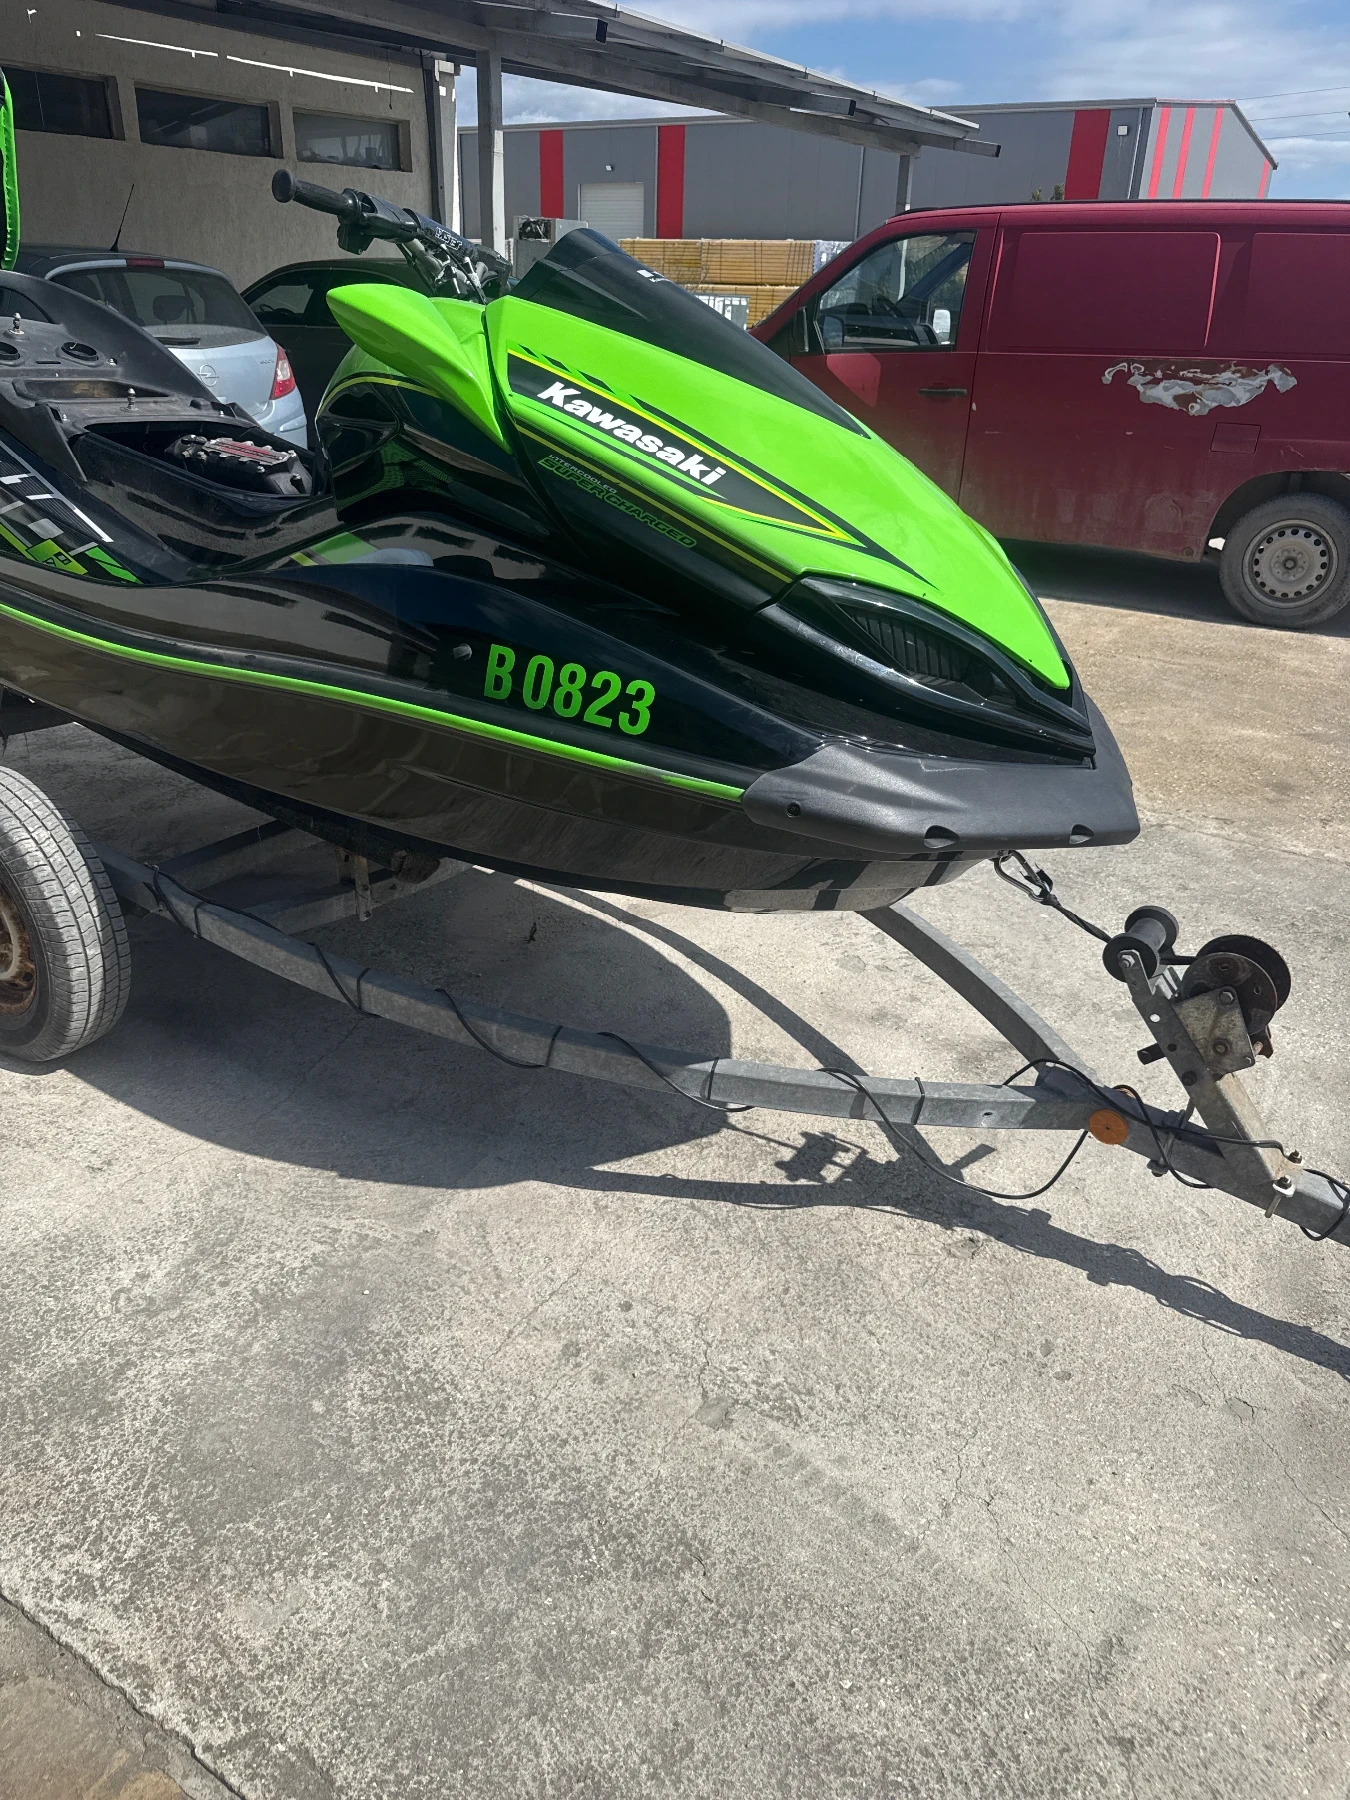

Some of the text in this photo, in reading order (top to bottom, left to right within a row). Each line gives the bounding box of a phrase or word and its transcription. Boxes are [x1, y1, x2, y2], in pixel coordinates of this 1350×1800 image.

[537, 382, 727, 486] Kawasaki
[538, 456, 697, 548] SUPERCHARGED
[484, 643, 656, 736] B 0823
